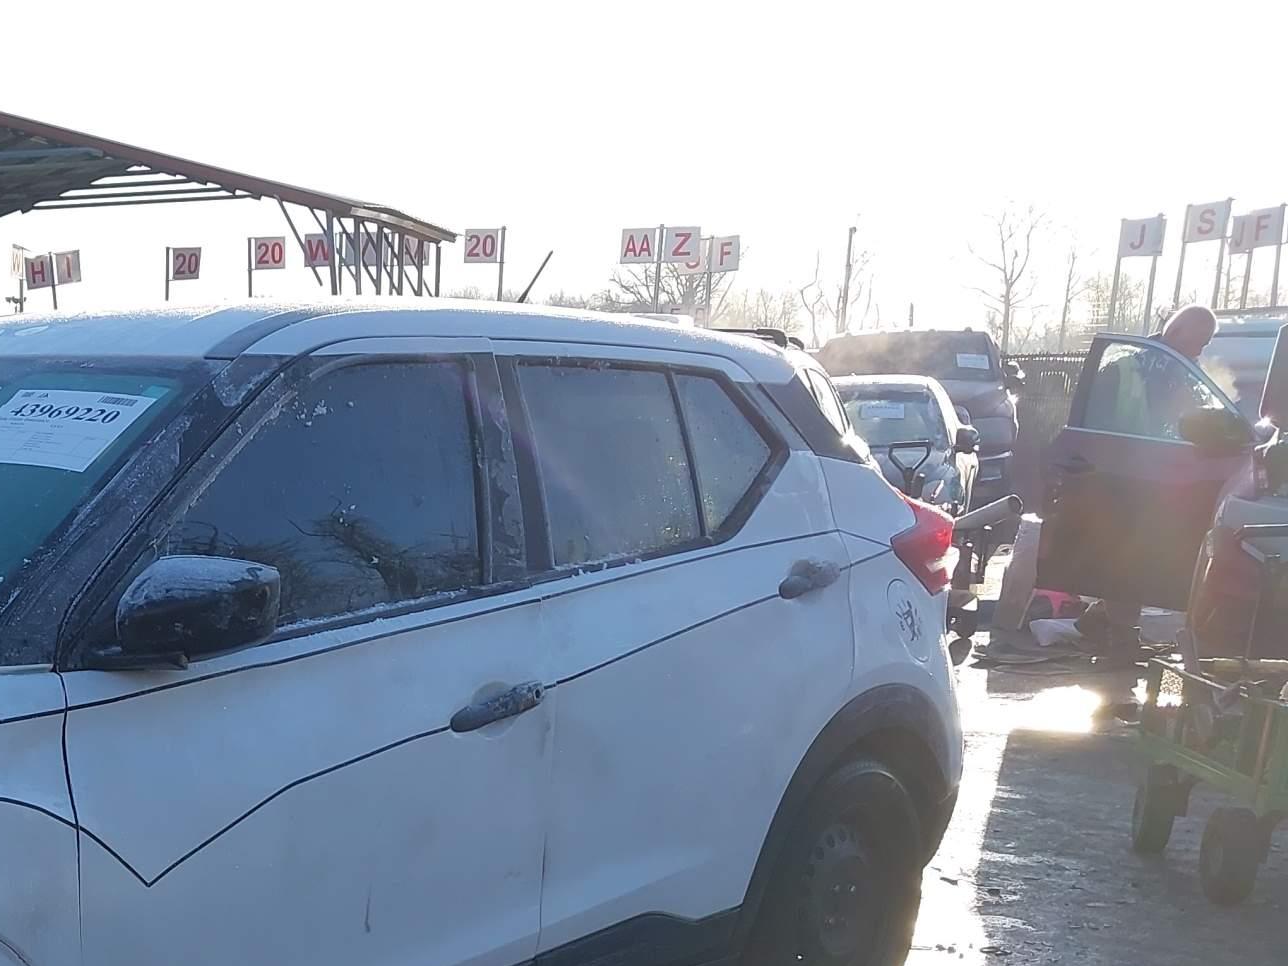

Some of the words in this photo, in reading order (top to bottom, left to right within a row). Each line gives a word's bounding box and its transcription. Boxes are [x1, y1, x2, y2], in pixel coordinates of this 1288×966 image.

[1197, 209, 1216, 235] S
[1255, 214, 1272, 241] F
[467, 235, 496, 257] 20
[623, 234, 652, 257] AA
[672, 232, 692, 257] Z
[1129, 223, 1146, 250] J
[175, 252, 199, 275] 20
[257, 242, 283, 265] 20
[719, 241, 733, 266] F
[30, 260, 46, 284] H
[10, 402, 121, 424] 43969220
